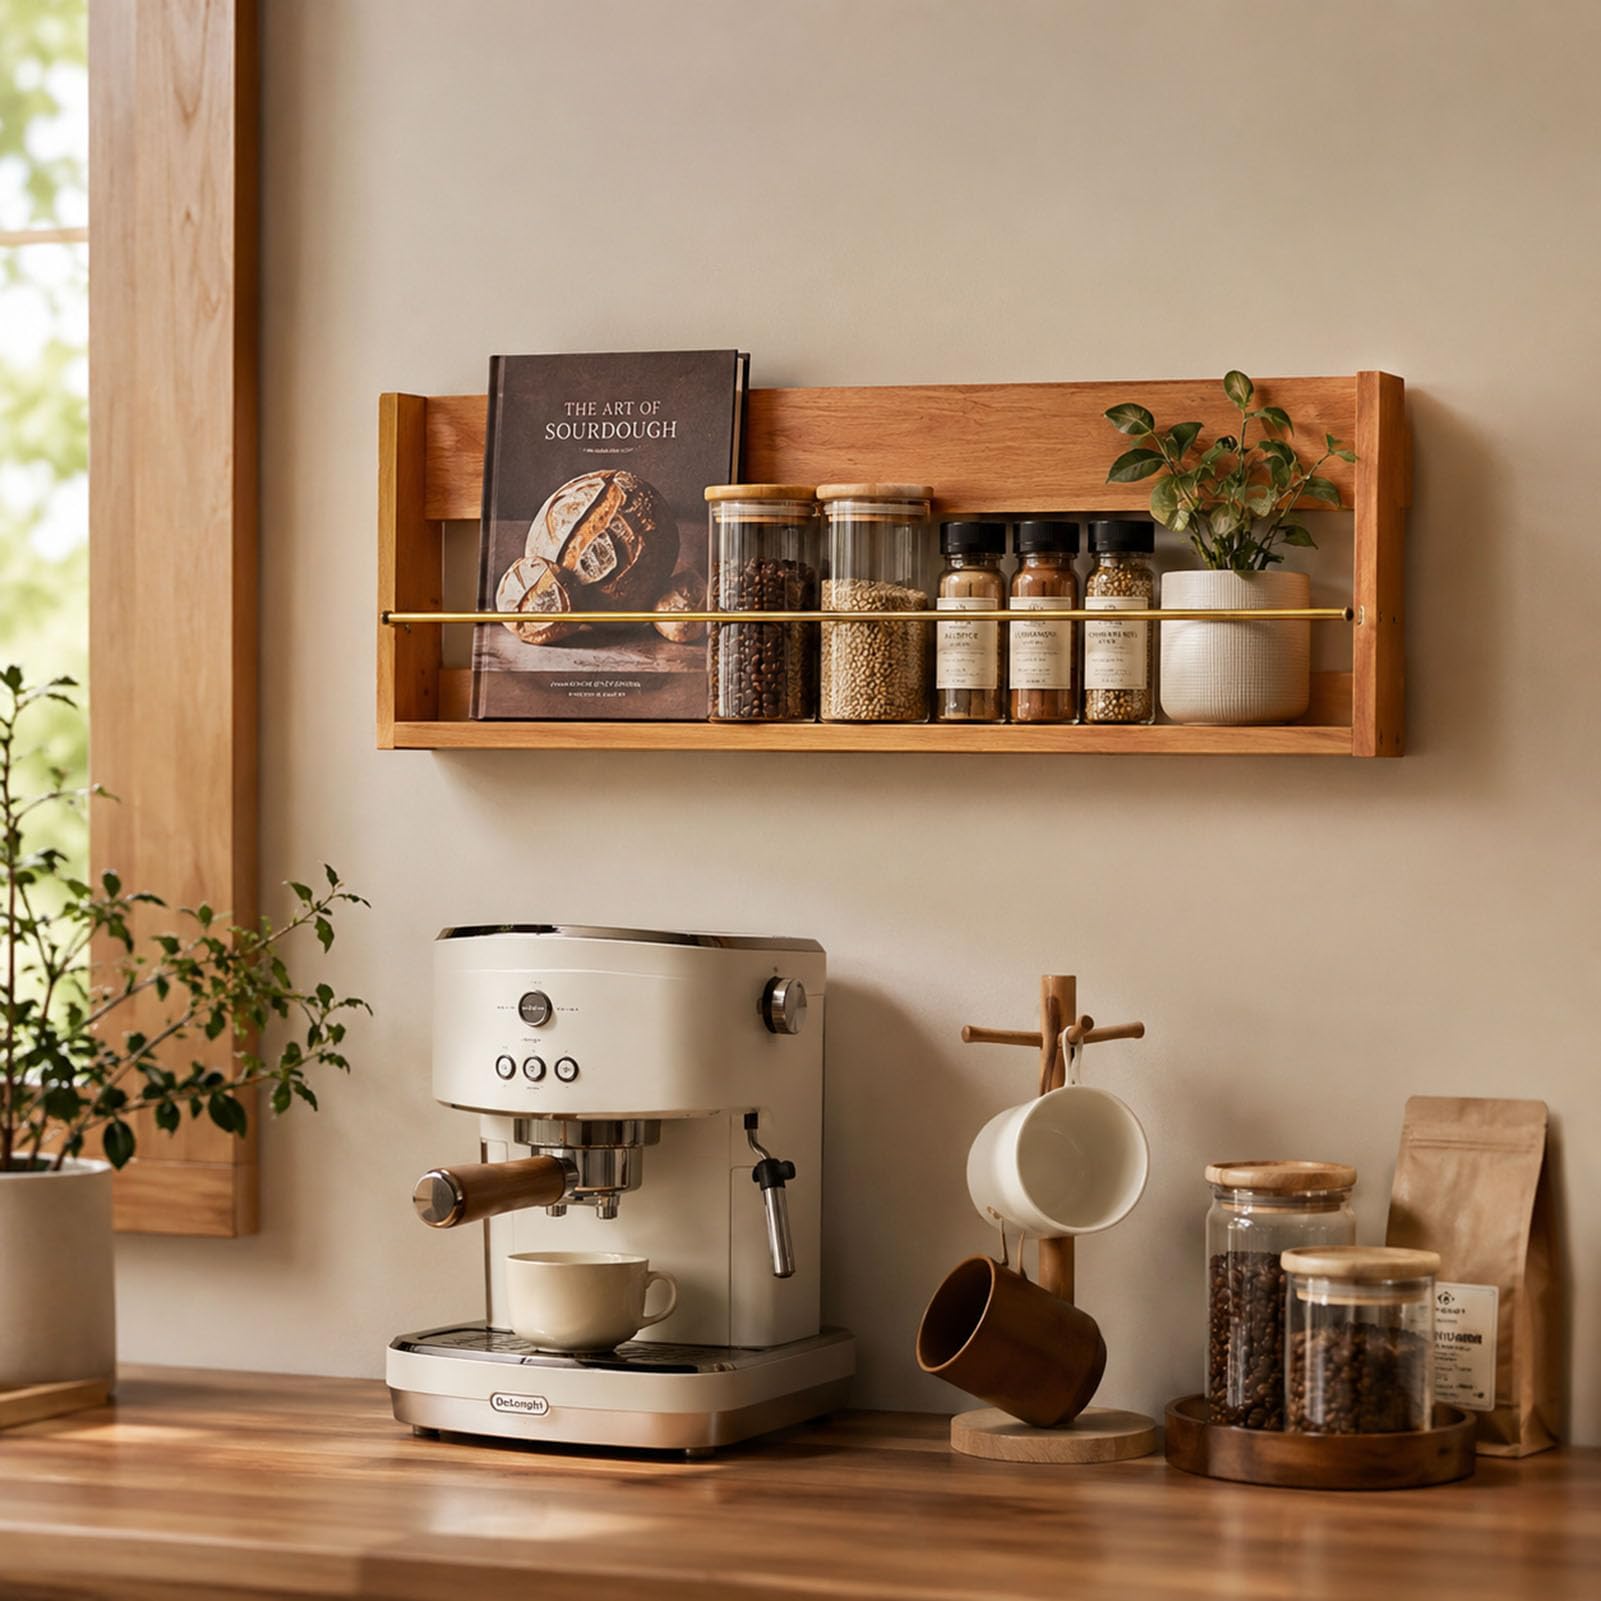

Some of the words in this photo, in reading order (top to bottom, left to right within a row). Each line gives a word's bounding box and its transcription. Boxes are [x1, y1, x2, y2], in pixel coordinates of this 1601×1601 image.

[564, 402, 597, 416] THE
[602, 401, 634, 415] ART
[639, 400, 661, 415] OF
[544, 420, 678, 440] SOURDOUGH
[496, 1396, 543, 1411] DeLonghi
